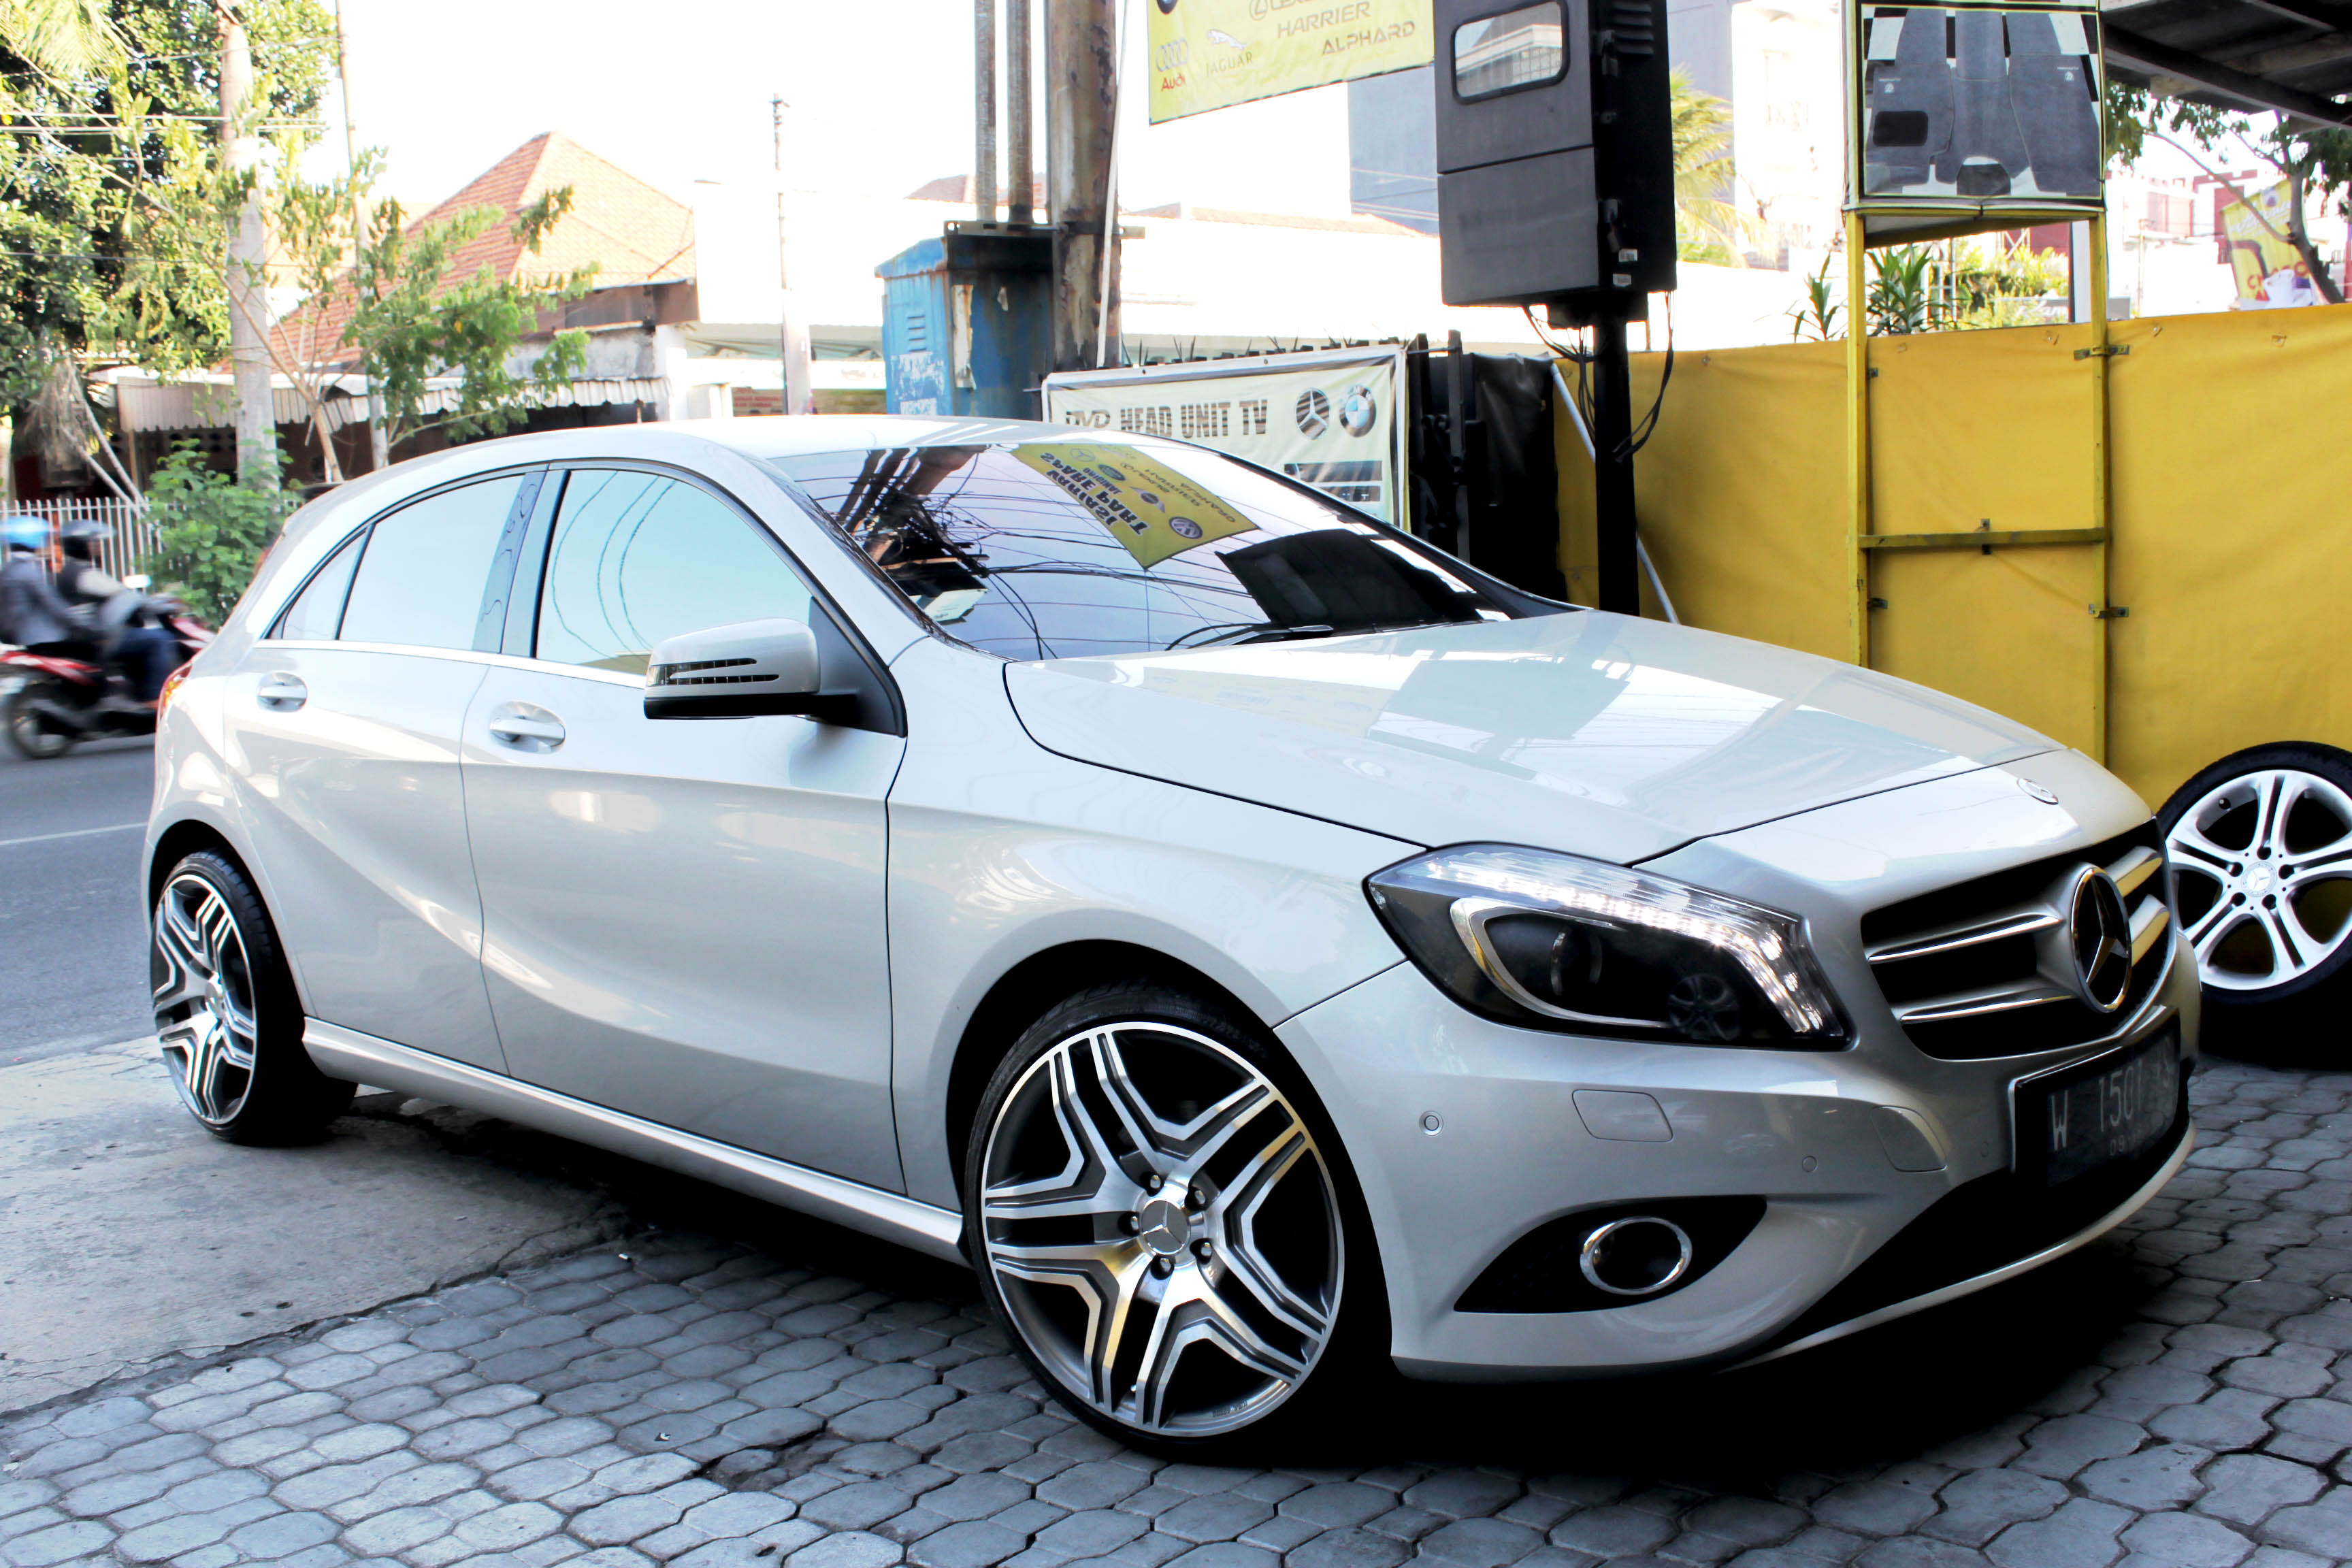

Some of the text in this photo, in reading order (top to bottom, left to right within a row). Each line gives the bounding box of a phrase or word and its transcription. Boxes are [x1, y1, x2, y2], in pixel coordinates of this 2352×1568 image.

[1277, 2, 1371, 39] HARRIER
[1322, 21, 1416, 56] ALPHARD
[1205, 52, 1254, 78] JAGUAR
[1065, 399, 1268, 439] DVD HEAD UNIT TV
[2051, 1090, 2069, 1152] W
